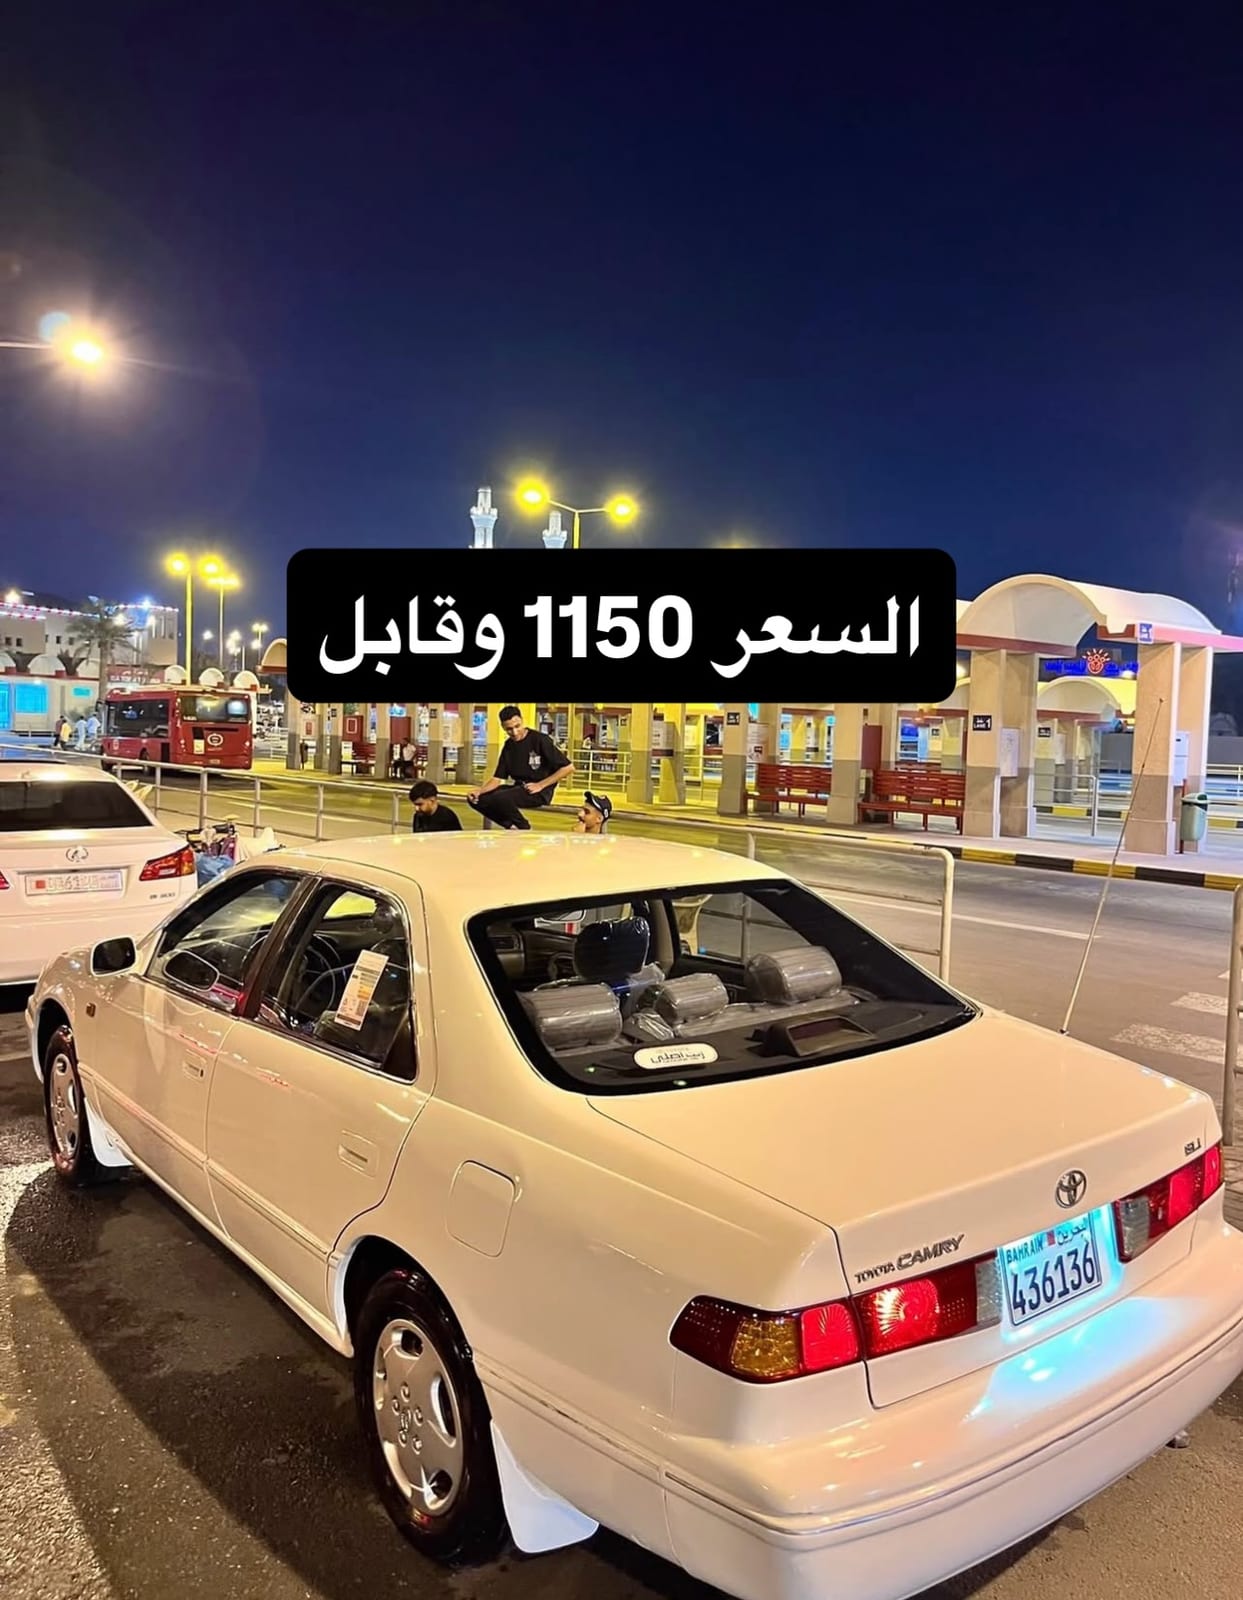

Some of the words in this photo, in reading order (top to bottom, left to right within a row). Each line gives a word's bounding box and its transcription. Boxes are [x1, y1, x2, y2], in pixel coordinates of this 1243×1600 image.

[854, 1262, 896, 1284] TOYOTA
[897, 1233, 965, 1271] CAMRY
[1006, 1236, 1044, 1264] BAHRAIN
[1011, 1239, 1095, 1315] 436136
